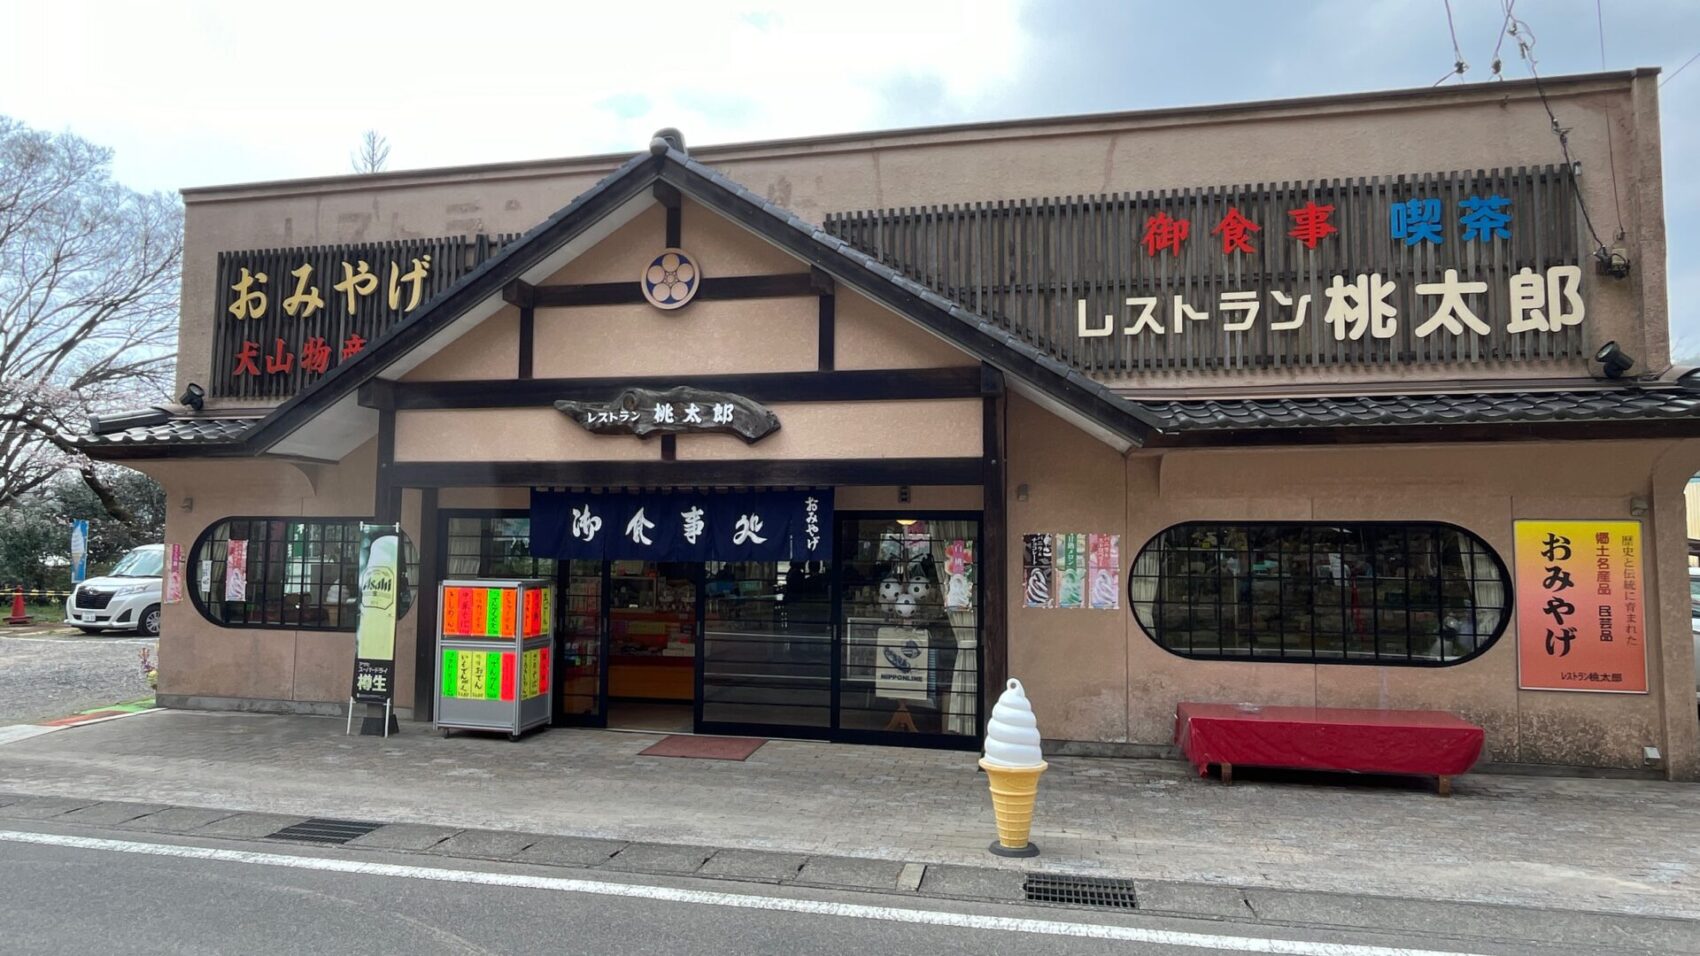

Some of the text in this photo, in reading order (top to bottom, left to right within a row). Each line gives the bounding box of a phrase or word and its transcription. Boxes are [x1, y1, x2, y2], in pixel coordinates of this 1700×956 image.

[1142, 195, 1513, 257] 御食事 喫茶
[229, 255, 431, 320] おみやげ
[573, 504, 767, 545] 御食事処
[805, 496, 819, 551] おみやげ
[363, 577, 392, 592] Asahi
[1541, 532, 1577, 657] おみやげ
[1622, 535, 1638, 647] 歴史と伝統に育まれた
[1599, 606, 1614, 642] 民芸品
[357, 673, 387, 692] 樽生
